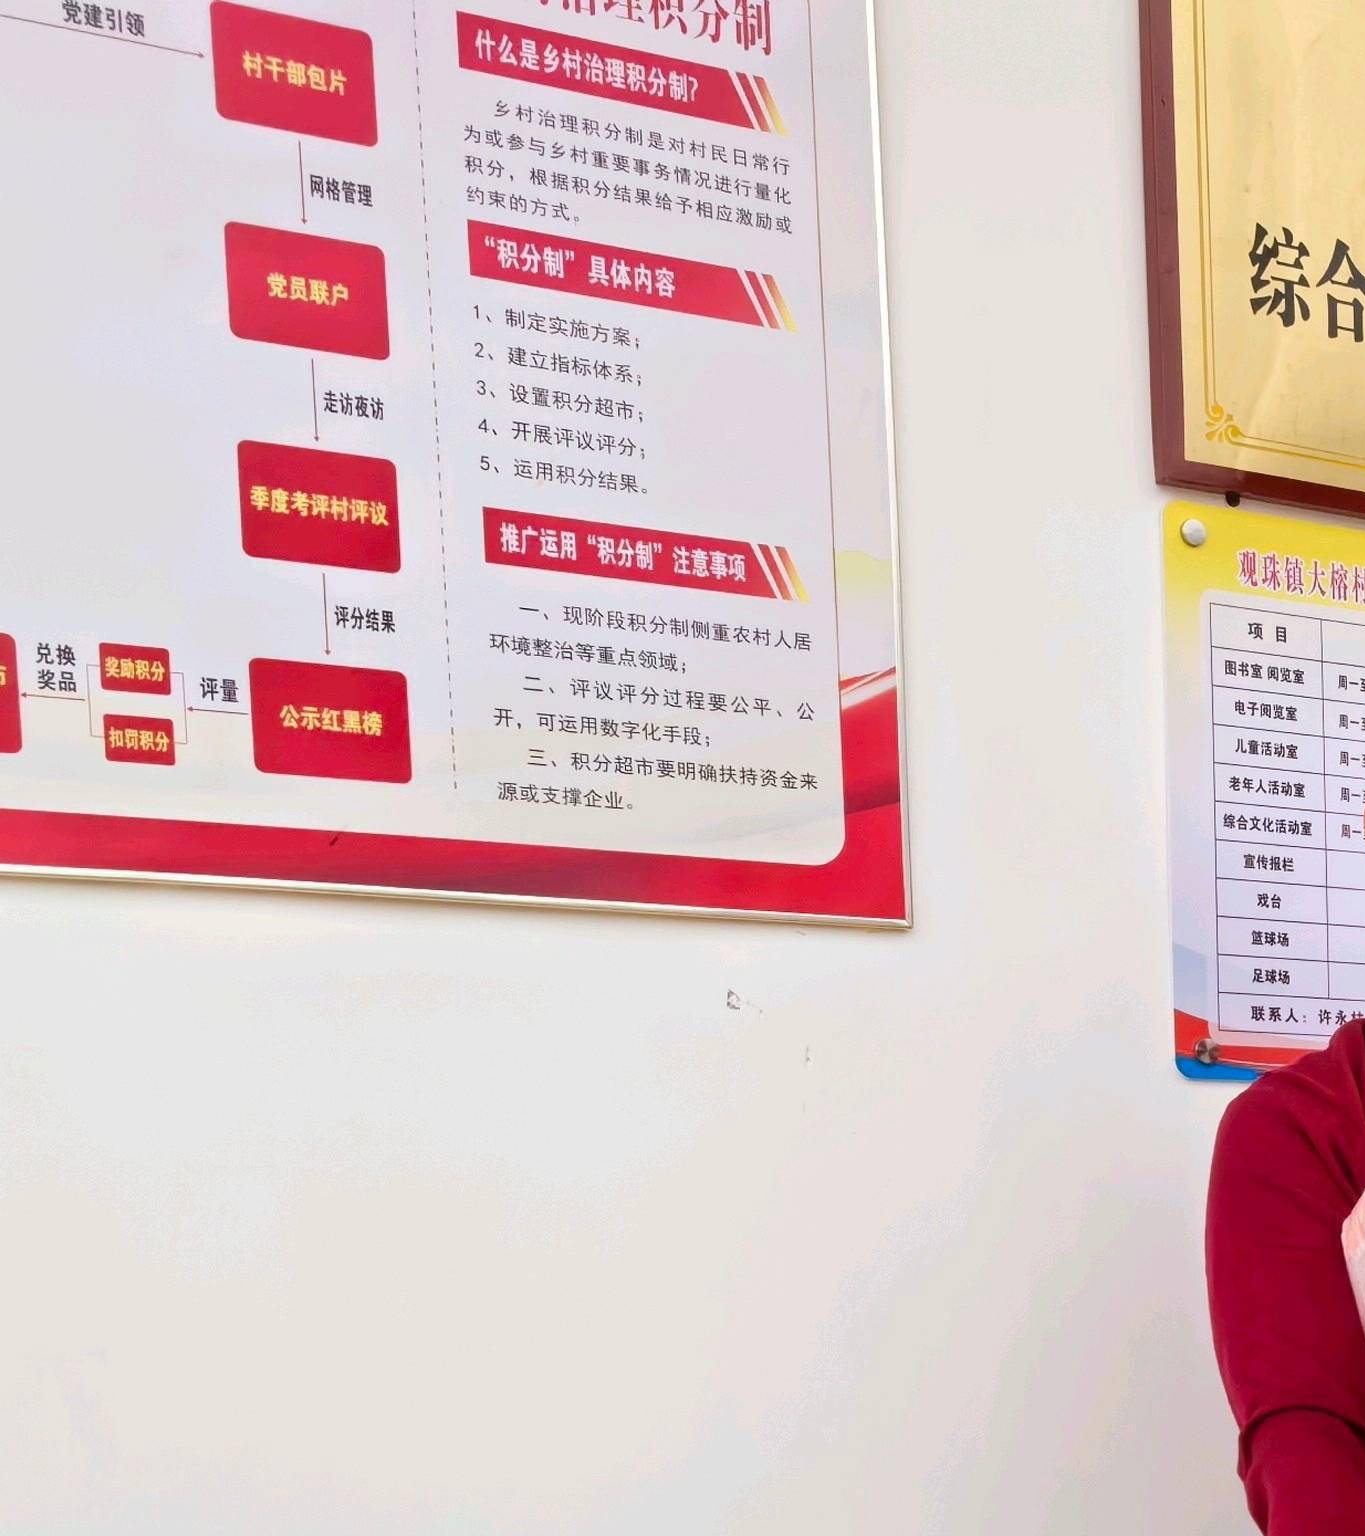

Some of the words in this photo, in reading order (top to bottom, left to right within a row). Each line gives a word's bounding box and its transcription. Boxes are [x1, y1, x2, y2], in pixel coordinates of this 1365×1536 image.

[61, 1, 146, 37] 党建引领
[243, 50, 347, 96] 村干部包片
[494, 100, 790, 176] 乡村治理积分制是对村民日常行
[464, 124, 792, 206] 为或参与乡村重要事务情况进行量化
[309, 174, 373, 207] 网格管理
[466, 185, 582, 225] 约束的方式。
[267, 272, 349, 307] 党员联户
[323, 390, 384, 420] 走访夜访
[249, 486, 389, 527] 季度考评村评议
[335, 606, 396, 633] 评分结果
[519, 604, 812, 652] 一、现阶段积分制侧重农村人居
[36, 642, 76, 667] 兑换
[37, 669, 77, 692] 奖品
[105, 655, 166, 682] 奖励积分
[1224, 660, 1263, 680] 图书室
[1267, 665, 1305, 685] 阅览室
[200, 677, 239, 703] 评量
[280, 704, 383, 737] 公示红黑榜
[1234, 700, 1298, 722] 电子阅览室
[108, 725, 170, 753] 扣罚积分
[1235, 739, 1298, 760] 儿童活动室
[527, 748, 818, 792] 三、积分超市要明确扶持资金来
[497, 781, 636, 811] 源或支撑企业。
[1229, 777, 1305, 798] 老年人活动室
[1223, 814, 1313, 836] 综合文化活动室
[1243, 853, 1294, 873] 宣传报栏
[1257, 893, 1282, 909] 戏台
[1251, 930, 1290, 948] 篮球场
[1252, 968, 1290, 984] 足球场
